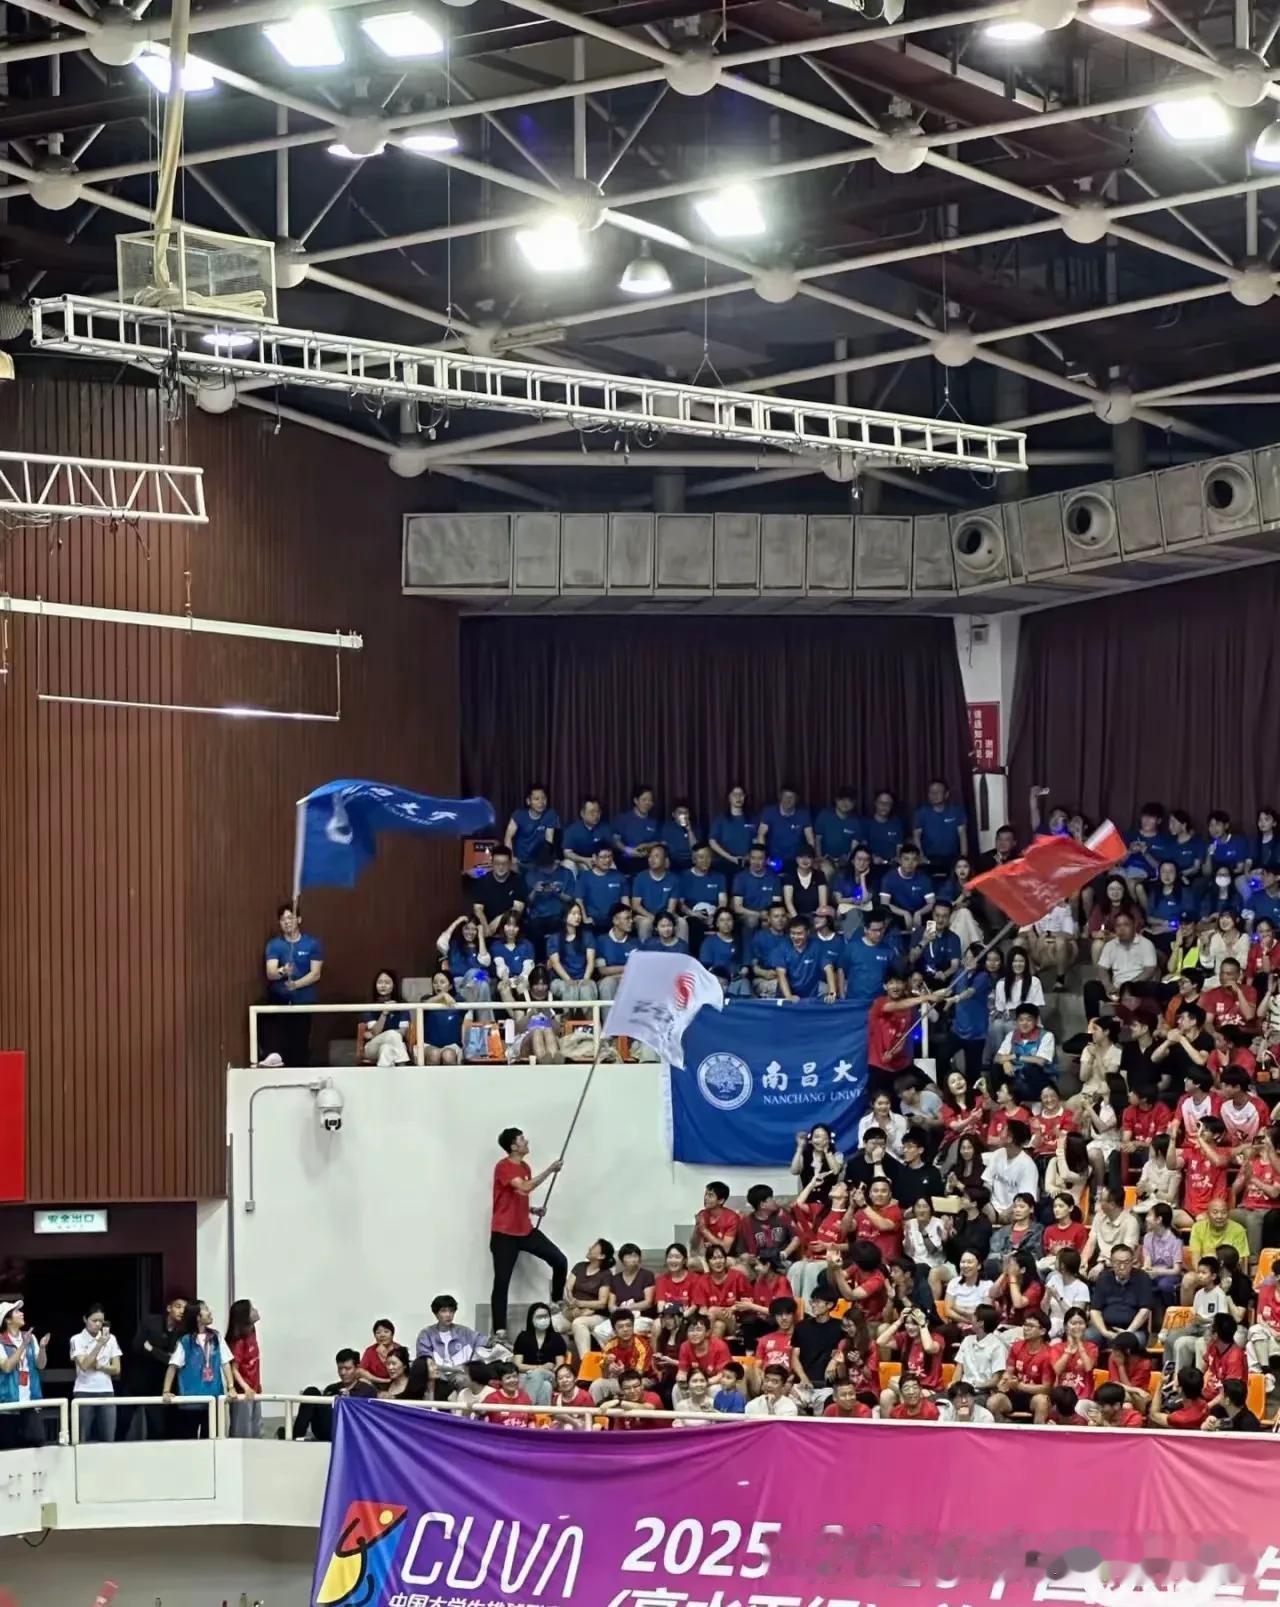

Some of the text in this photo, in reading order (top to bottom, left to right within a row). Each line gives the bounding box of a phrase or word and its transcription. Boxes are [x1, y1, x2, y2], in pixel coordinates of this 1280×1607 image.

[762, 1060, 858, 1091] 南昌大
[763, 1092, 826, 1104] NANCHANG
[402, 1512, 584, 1598] CUVA
[621, 1517, 781, 1578] 2025
